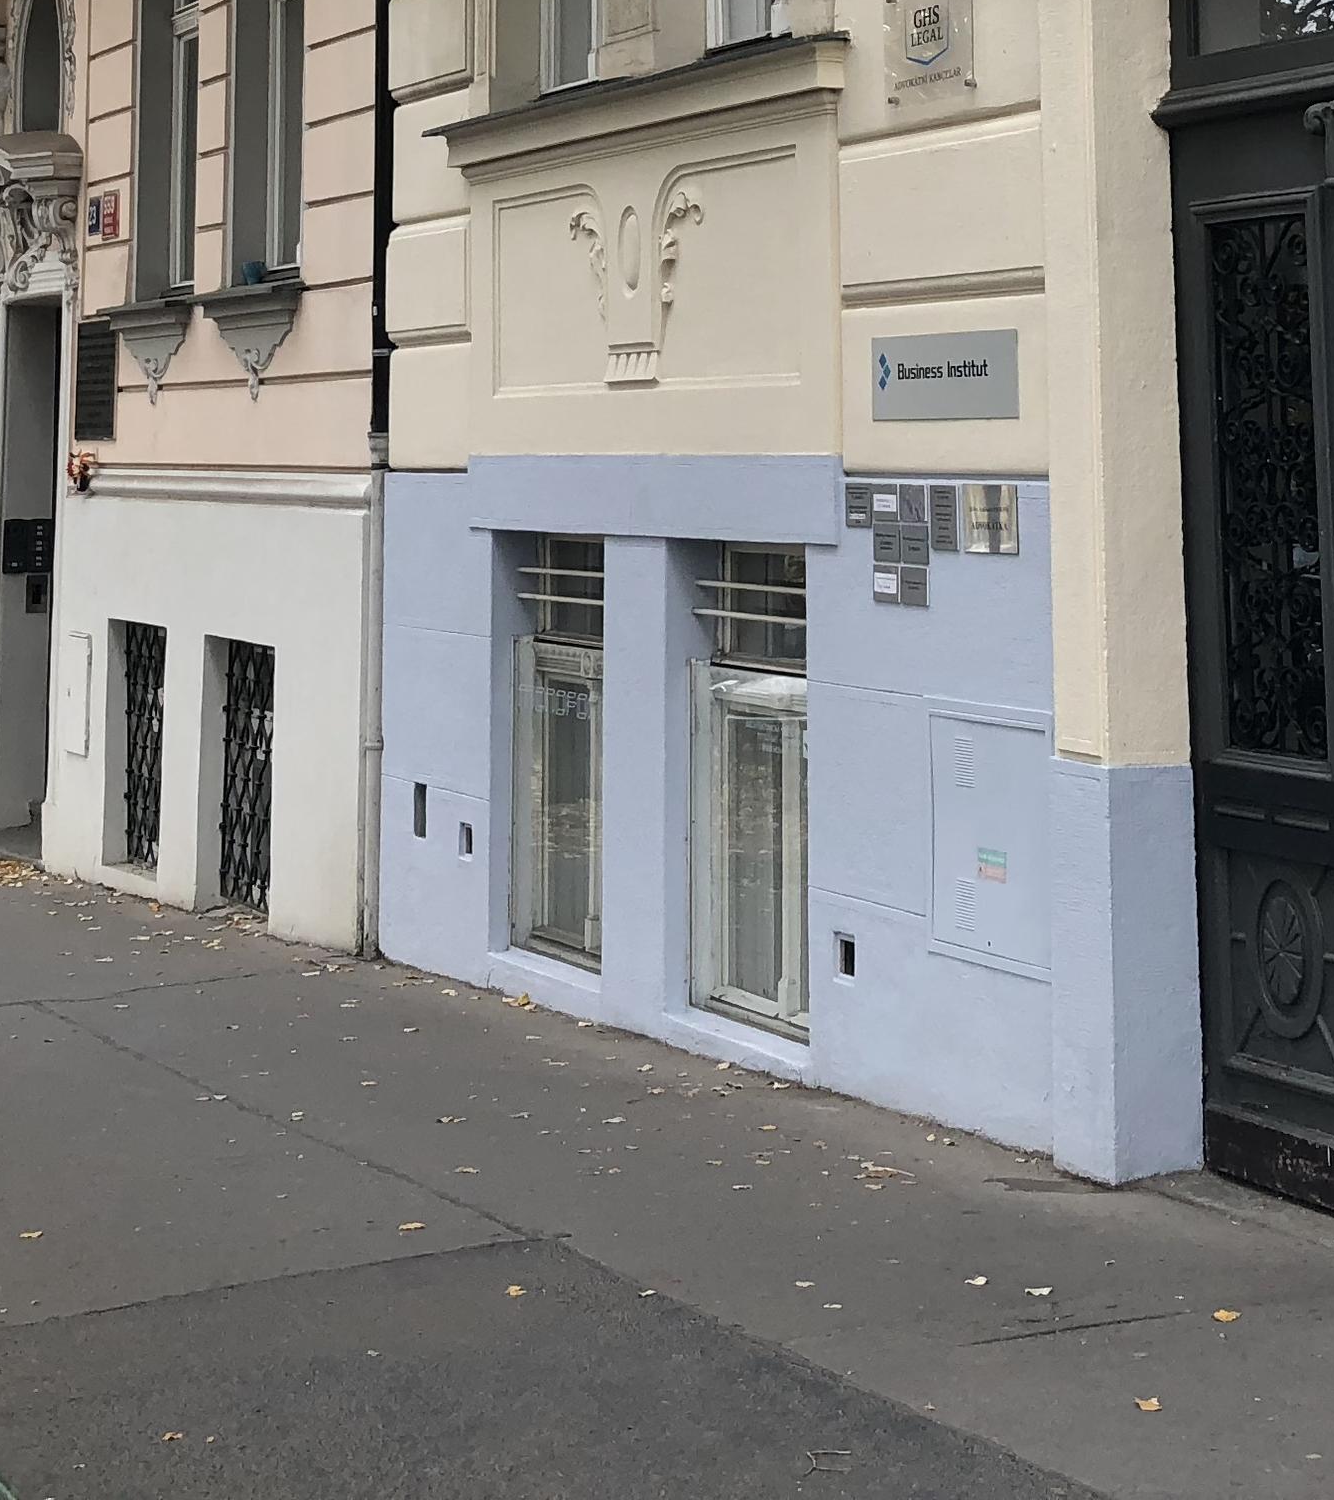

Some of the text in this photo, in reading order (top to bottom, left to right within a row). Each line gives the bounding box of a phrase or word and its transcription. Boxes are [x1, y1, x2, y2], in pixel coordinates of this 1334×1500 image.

[913, 4, 940, 29] GHS
[910, 26, 944, 48] LEGAL
[897, 359, 989, 380] Business Institut
